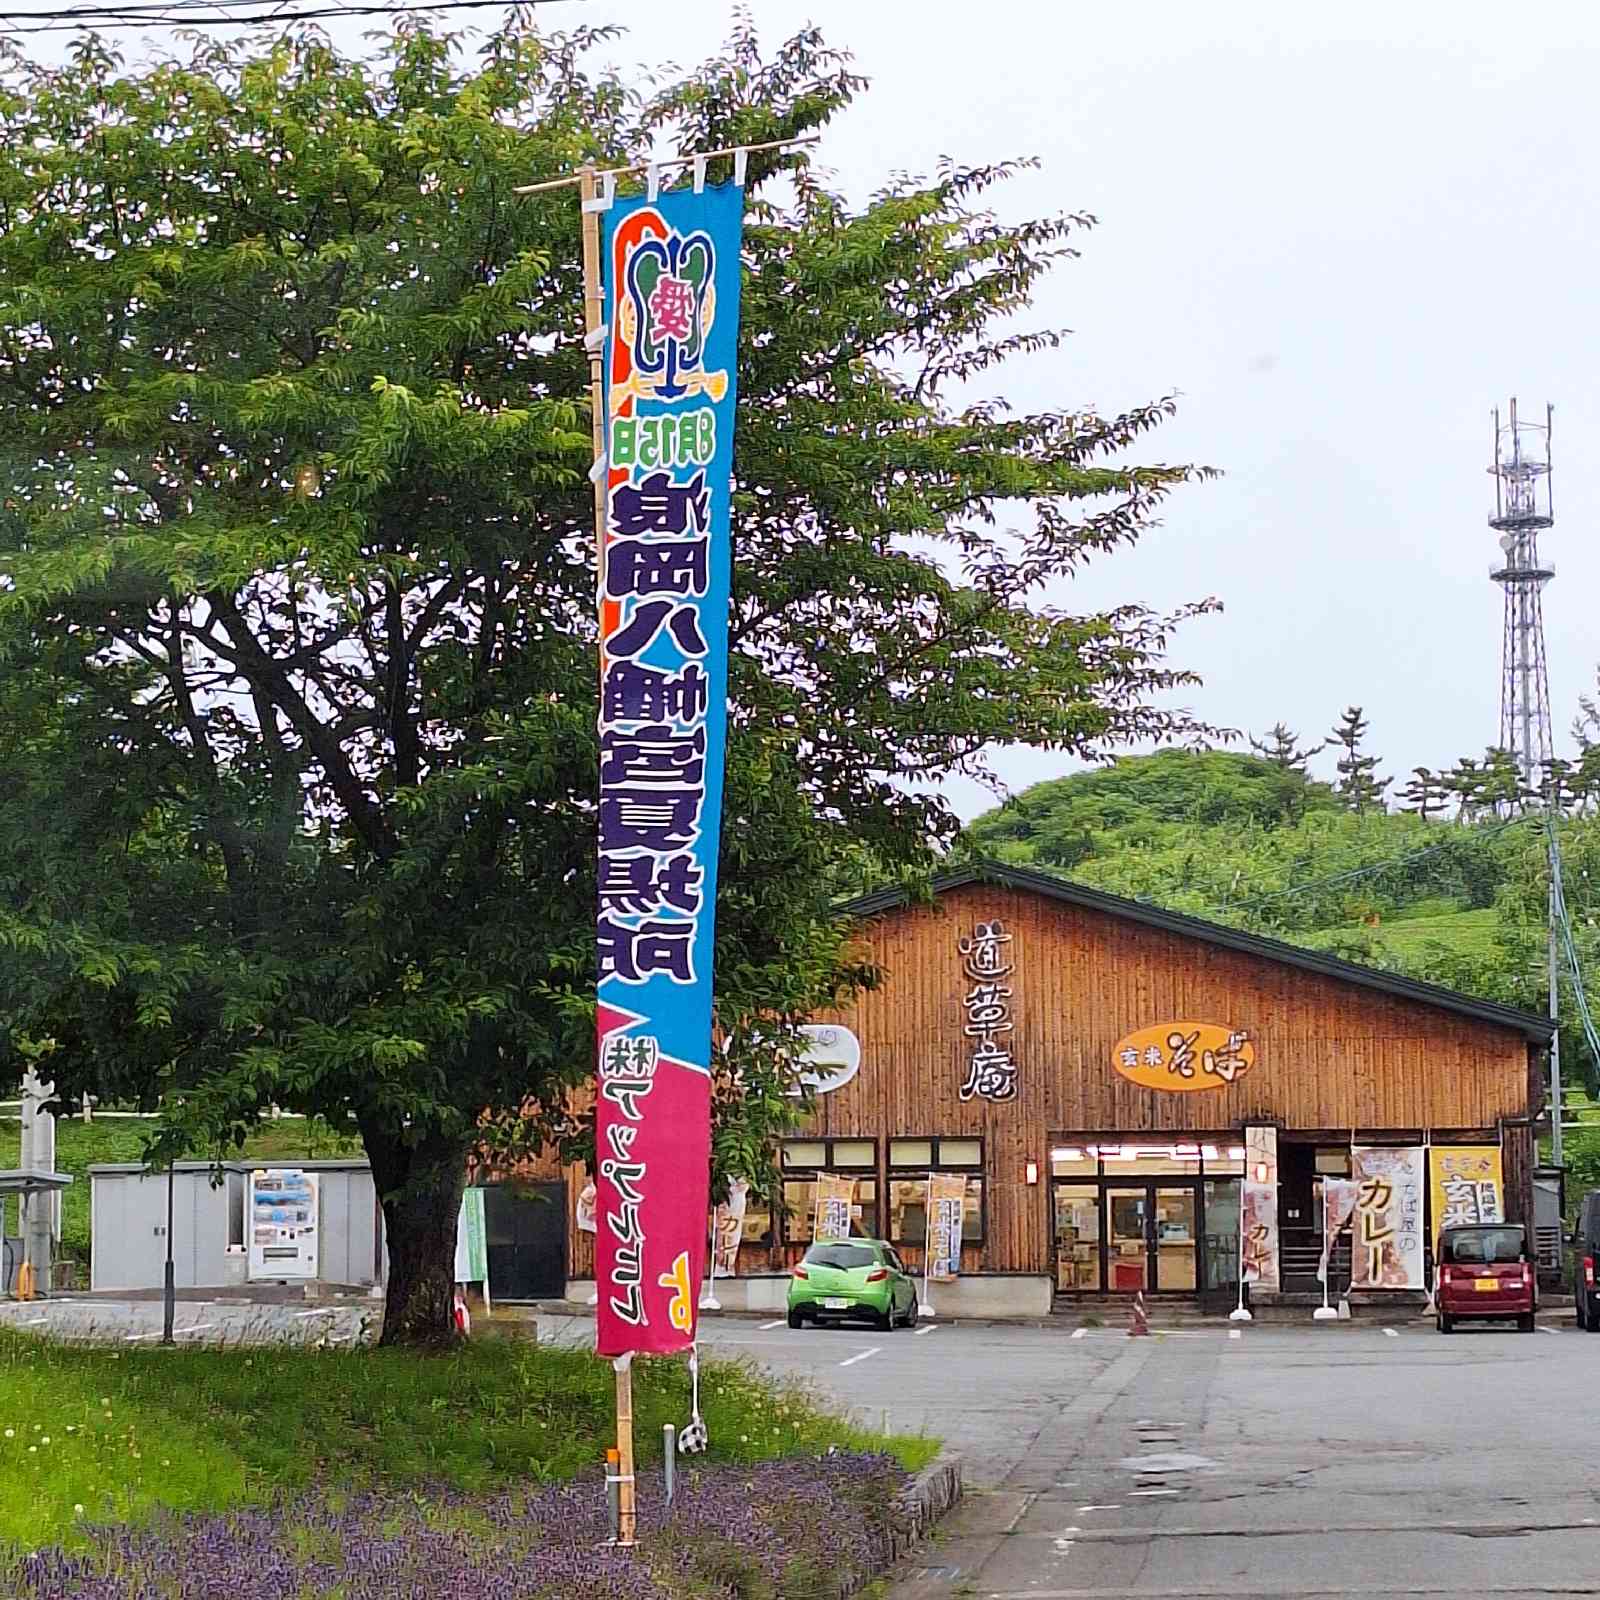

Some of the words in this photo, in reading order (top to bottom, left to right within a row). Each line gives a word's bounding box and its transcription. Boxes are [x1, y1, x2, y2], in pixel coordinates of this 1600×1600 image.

[1252, 1223, 1272, 1280] カレー
[1358, 1177, 1394, 1283] カレー
